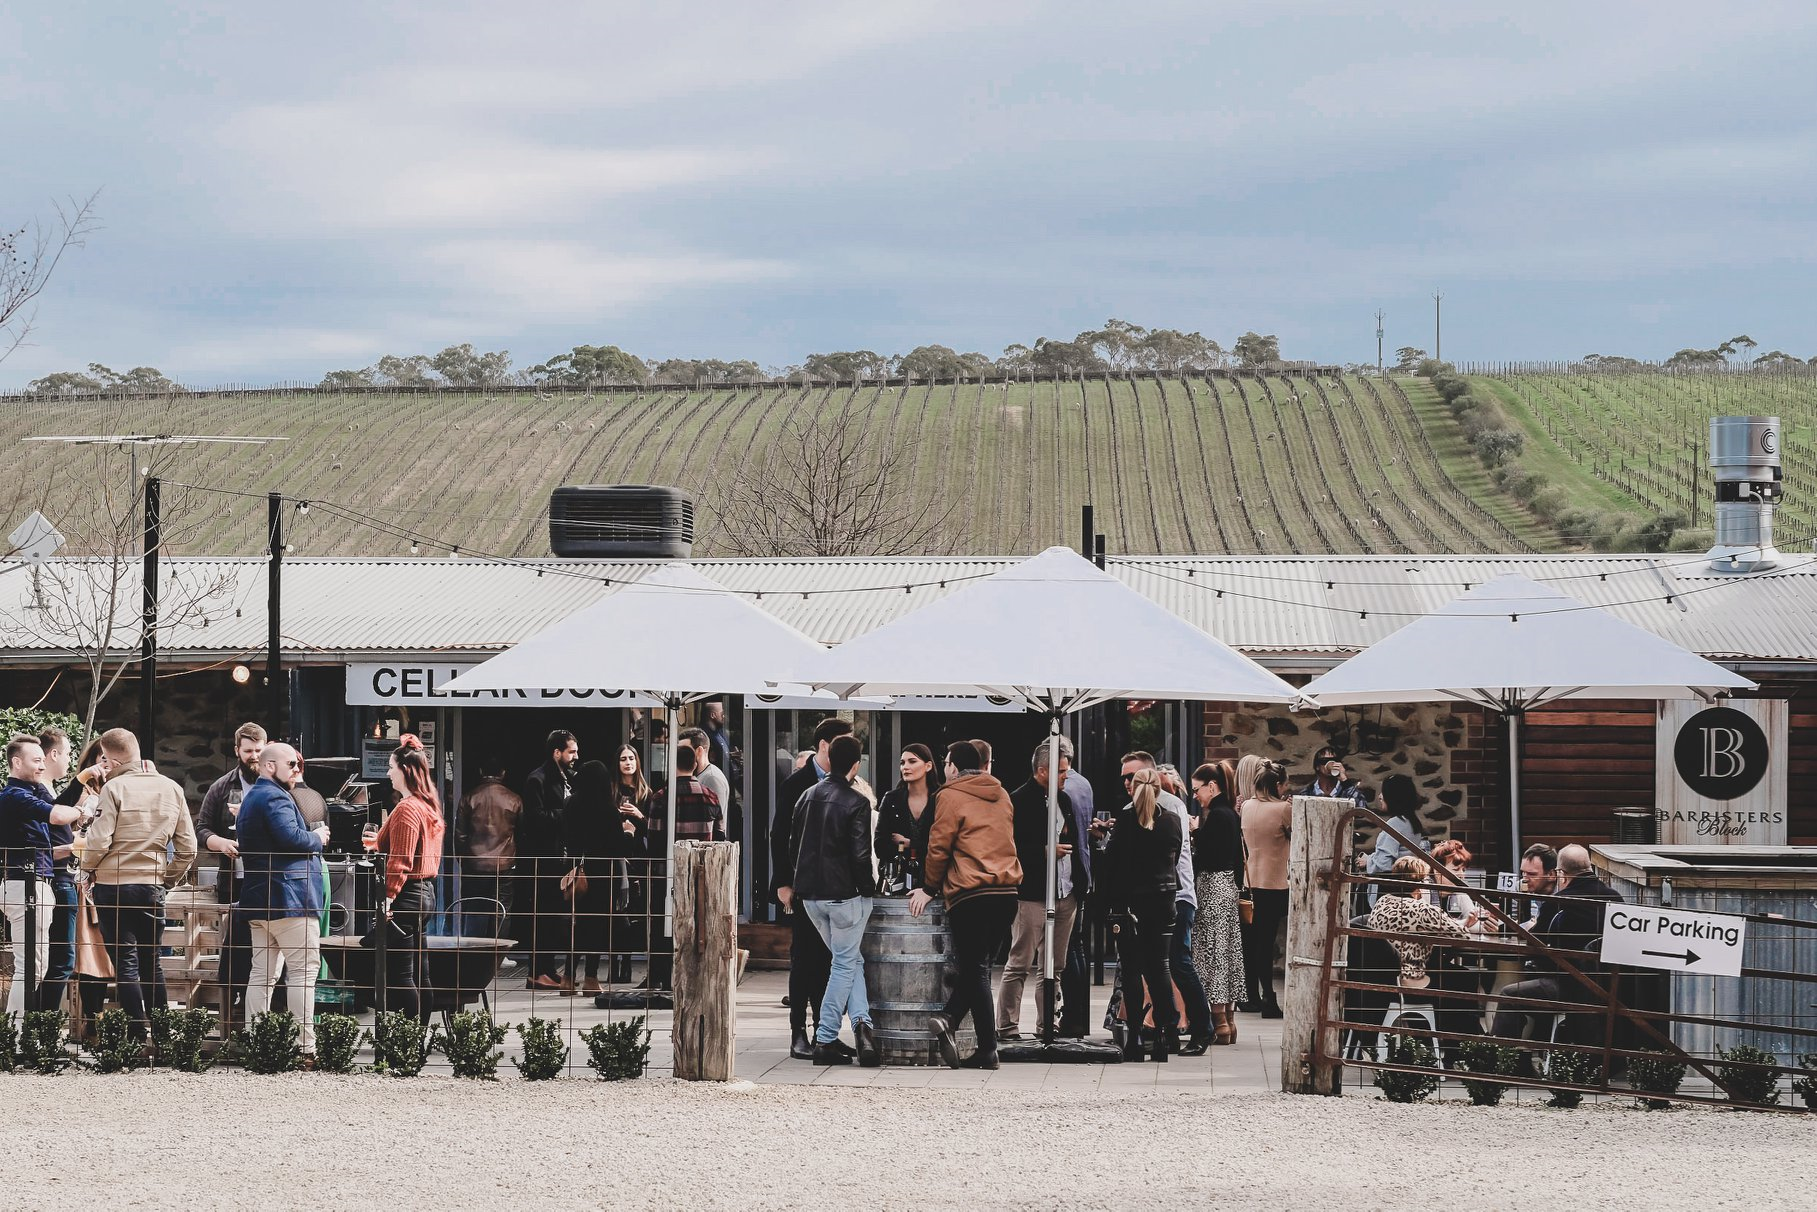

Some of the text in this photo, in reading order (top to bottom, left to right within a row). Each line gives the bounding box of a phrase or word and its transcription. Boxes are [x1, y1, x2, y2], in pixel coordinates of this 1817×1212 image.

[372, 667, 527, 698] CELL
[1660, 810, 1783, 824] BARRISTERS
[1696, 817, 1748, 837] Block
[1501, 875, 1514, 888] 15
[1610, 911, 1739, 947] Car Parking
